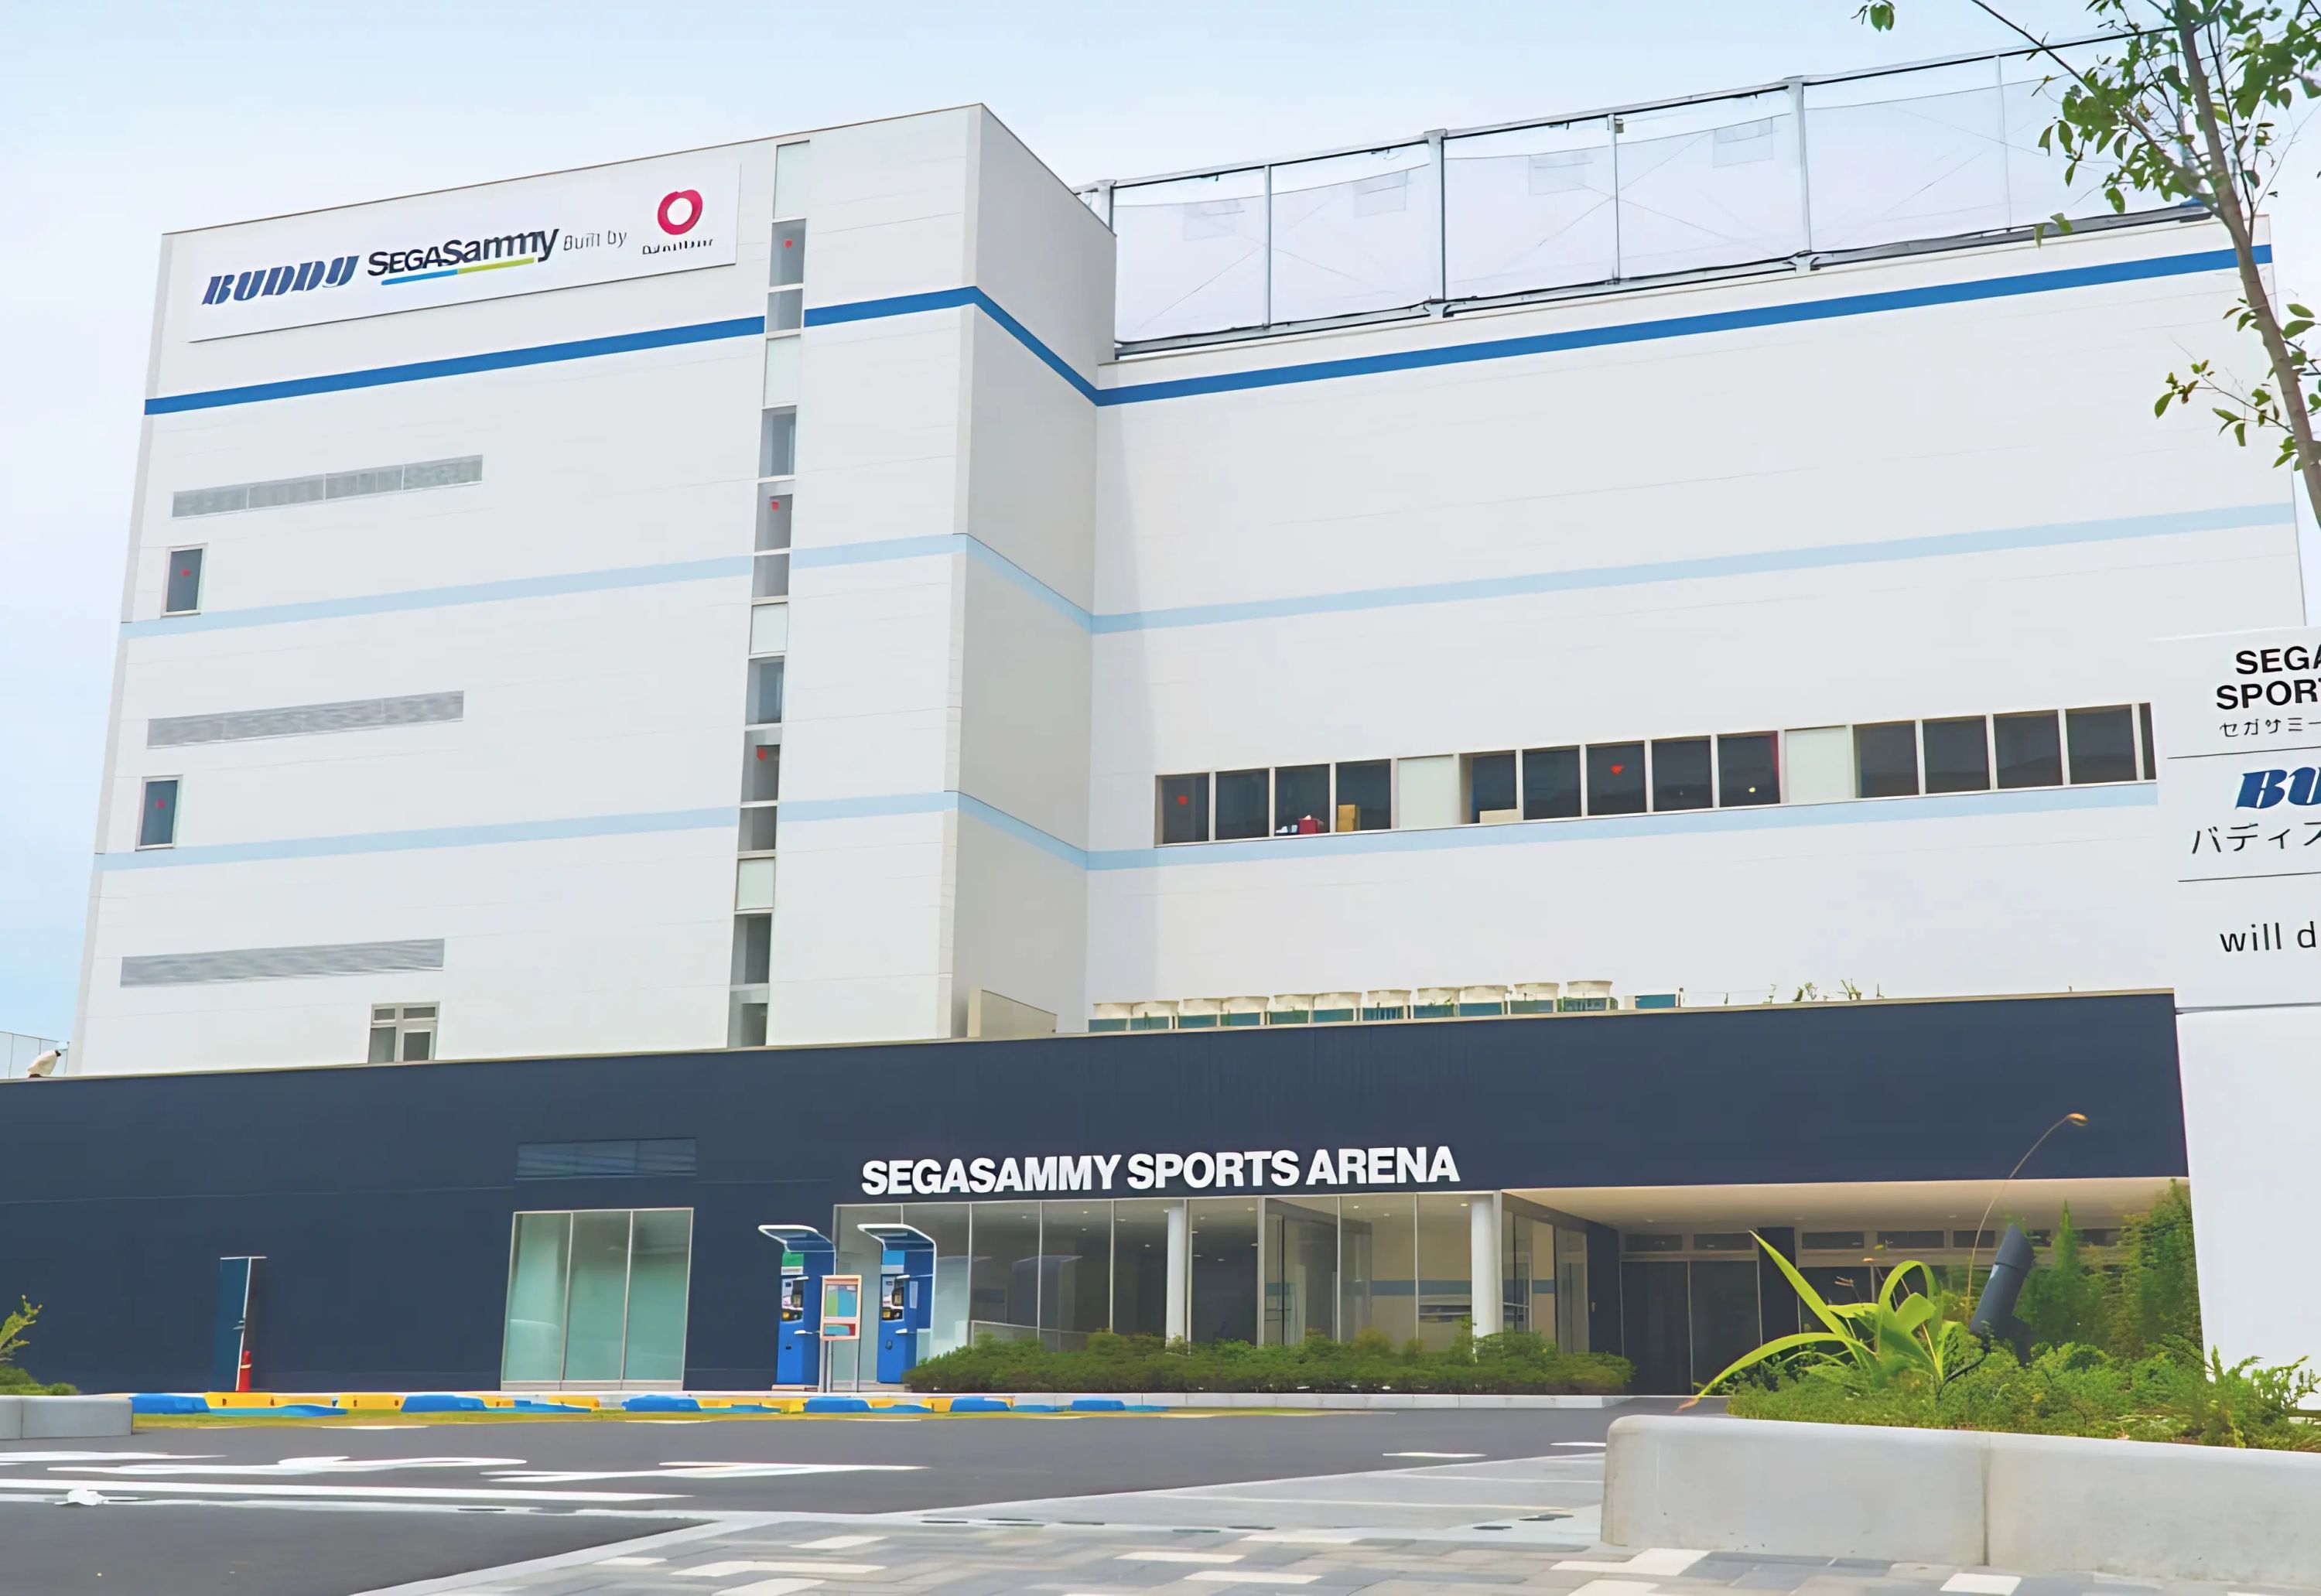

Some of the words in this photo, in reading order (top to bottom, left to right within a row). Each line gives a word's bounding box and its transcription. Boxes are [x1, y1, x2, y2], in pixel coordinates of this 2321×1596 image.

[202, 255, 360, 305] BUDDY
[2217, 678, 2321, 710] SPOR
[2220, 922, 2282, 952] will
[861, 1154, 1122, 1195] SEGASAMMY
[1126, 1150, 1300, 1189] SPORTS
[1305, 1146, 1461, 1185] ARENA
